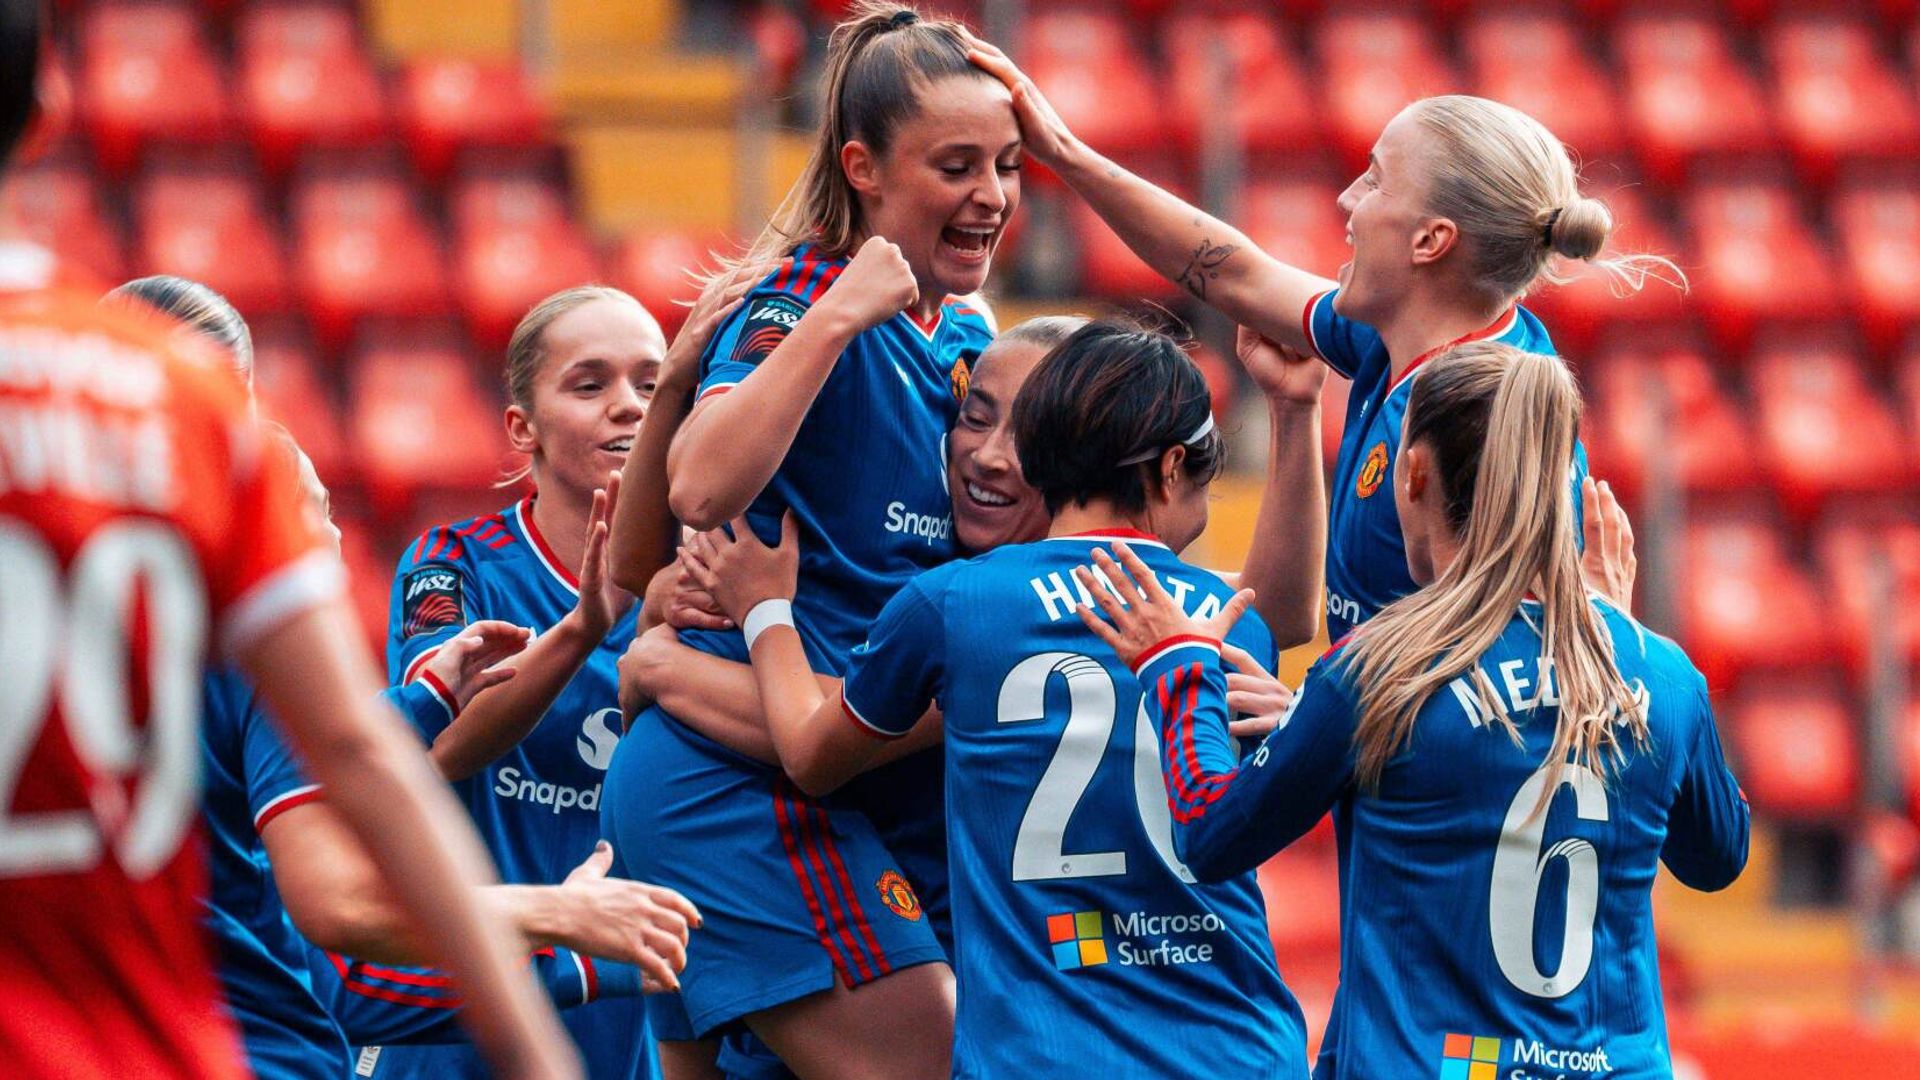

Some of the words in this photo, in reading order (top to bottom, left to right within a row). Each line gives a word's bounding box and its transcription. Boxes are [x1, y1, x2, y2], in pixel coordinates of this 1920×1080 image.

[884, 501, 952, 546] Snapd
[1029, 561, 1223, 622] HINTA
[1326, 586, 1360, 624] on
[0, 514, 207, 880] 29
[494, 766, 602, 814] Snapd
[1489, 763, 1609, 998] 6
[1117, 940, 1213, 966] Surface
[1513, 1038, 1613, 1072] Microsoft
